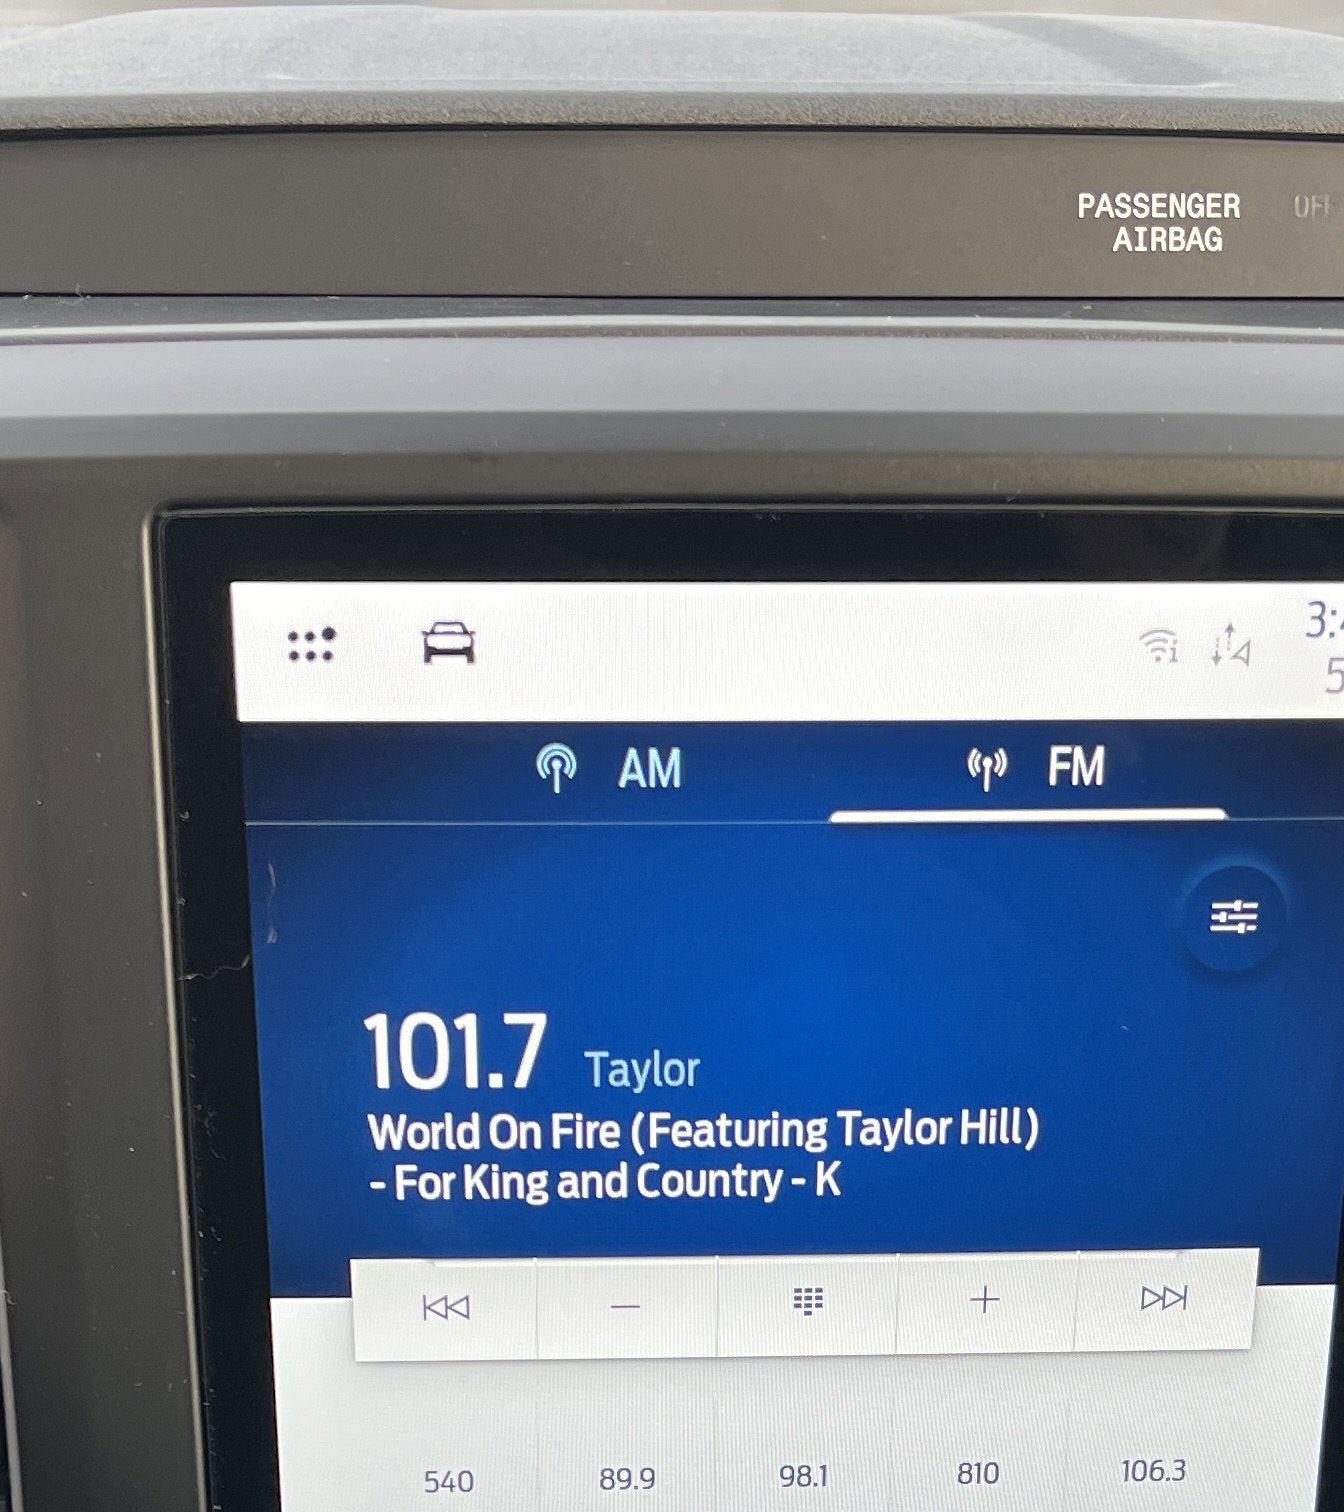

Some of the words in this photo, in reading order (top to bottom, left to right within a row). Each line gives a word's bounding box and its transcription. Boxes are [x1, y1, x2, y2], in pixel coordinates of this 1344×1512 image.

[1078, 192, 1241, 219] PASSENGER
[1112, 225, 1223, 252] AIRBAG
[618, 746, 681, 788] AM
[1048, 745, 1105, 786] FM
[363, 1011, 548, 1091] 101.7
[583, 1048, 701, 1094] Taylor
[367, 1111, 481, 1151] World
[489, 1113, 542, 1150] On
[551, 1112, 621, 1150] Fire
[631, 1110, 829, 1156] (Featuring
[836, 1107, 954, 1153] Taylor
[960, 1106, 1039, 1152] Hill)
[395, 1164, 457, 1201] For
[463, 1163, 550, 1206] King
[557, 1160, 628, 1199] and
[637, 1160, 784, 1204] Country
[816, 1160, 842, 1197] K
[424, 1469, 474, 1494] 540
[599, 1467, 656, 1491] 89.9
[779, 1464, 827, 1488] 98.1
[957, 1461, 1000, 1485] 810
[1122, 1458, 1186, 1483] 106.3
